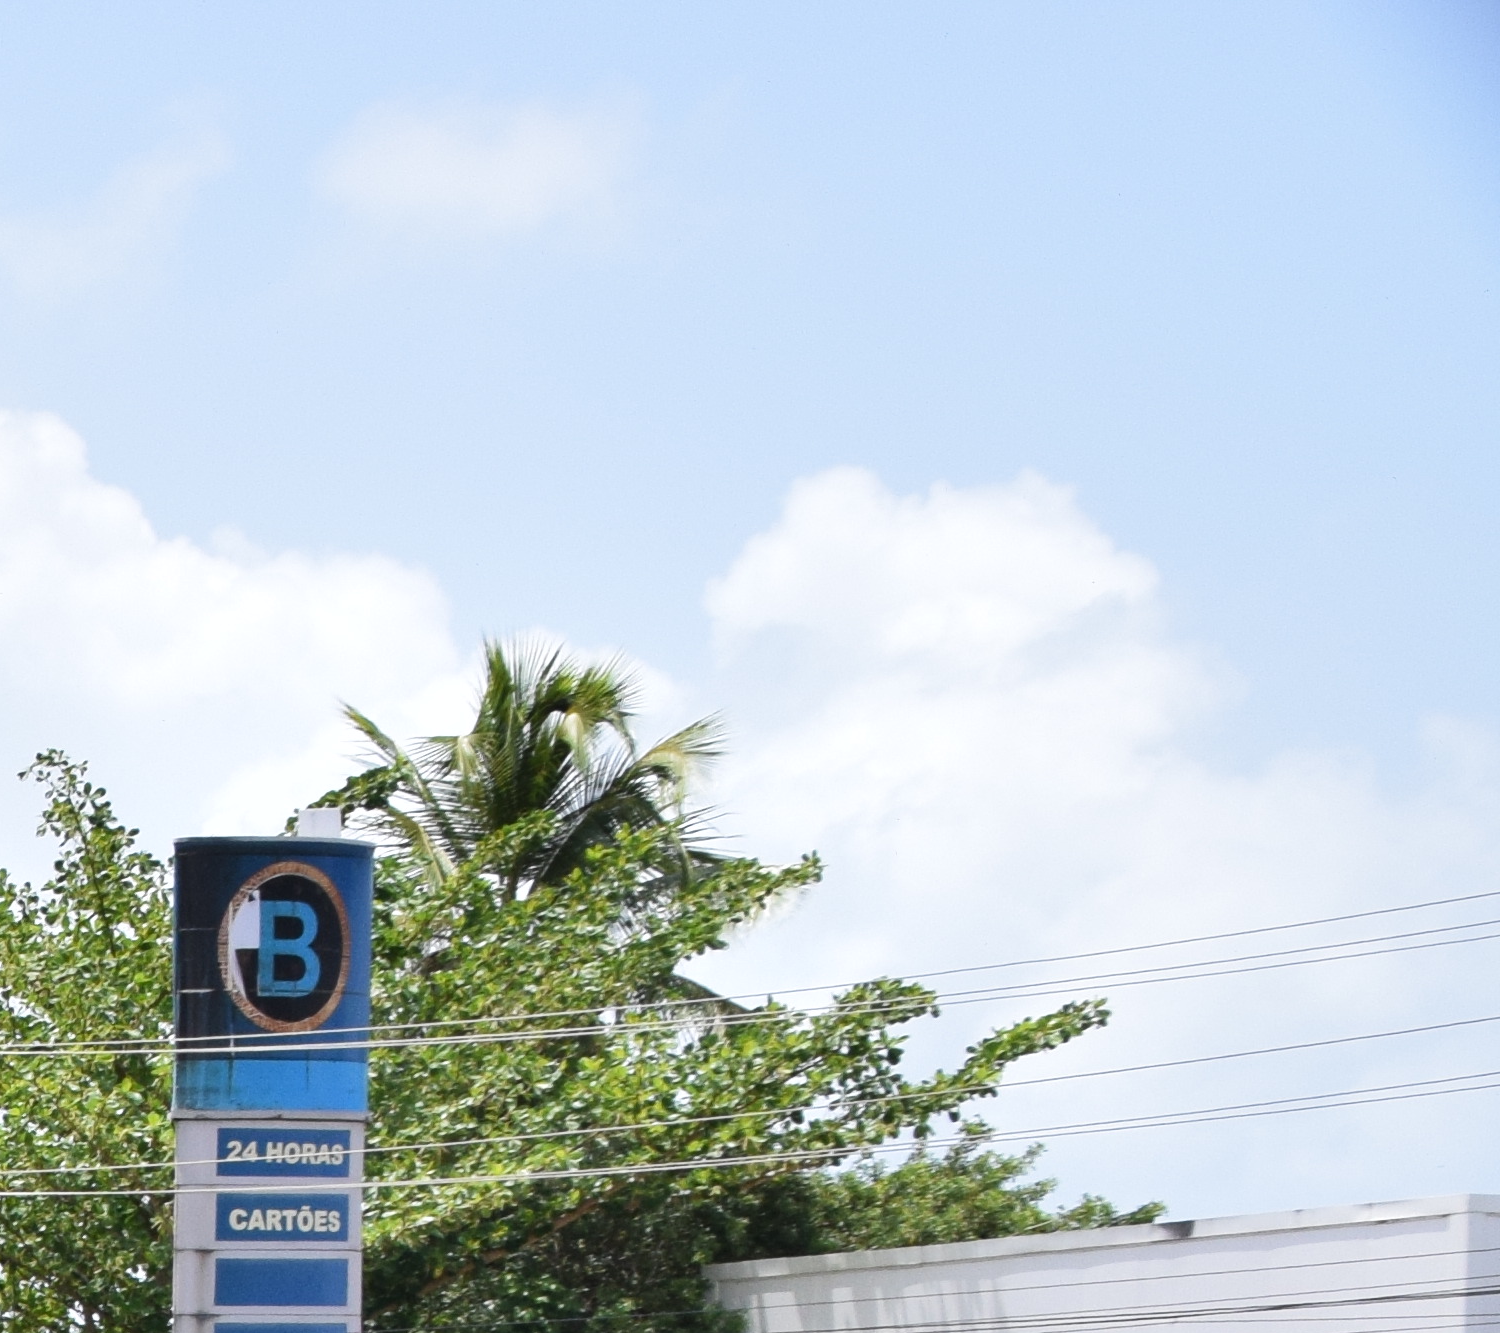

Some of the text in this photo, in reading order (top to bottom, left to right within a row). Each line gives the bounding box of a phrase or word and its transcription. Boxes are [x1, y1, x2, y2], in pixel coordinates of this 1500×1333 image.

[257, 900, 321, 998] B
[226, 1140, 344, 1165] 24 HORAS
[228, 1205, 341, 1233] CARTÕES
